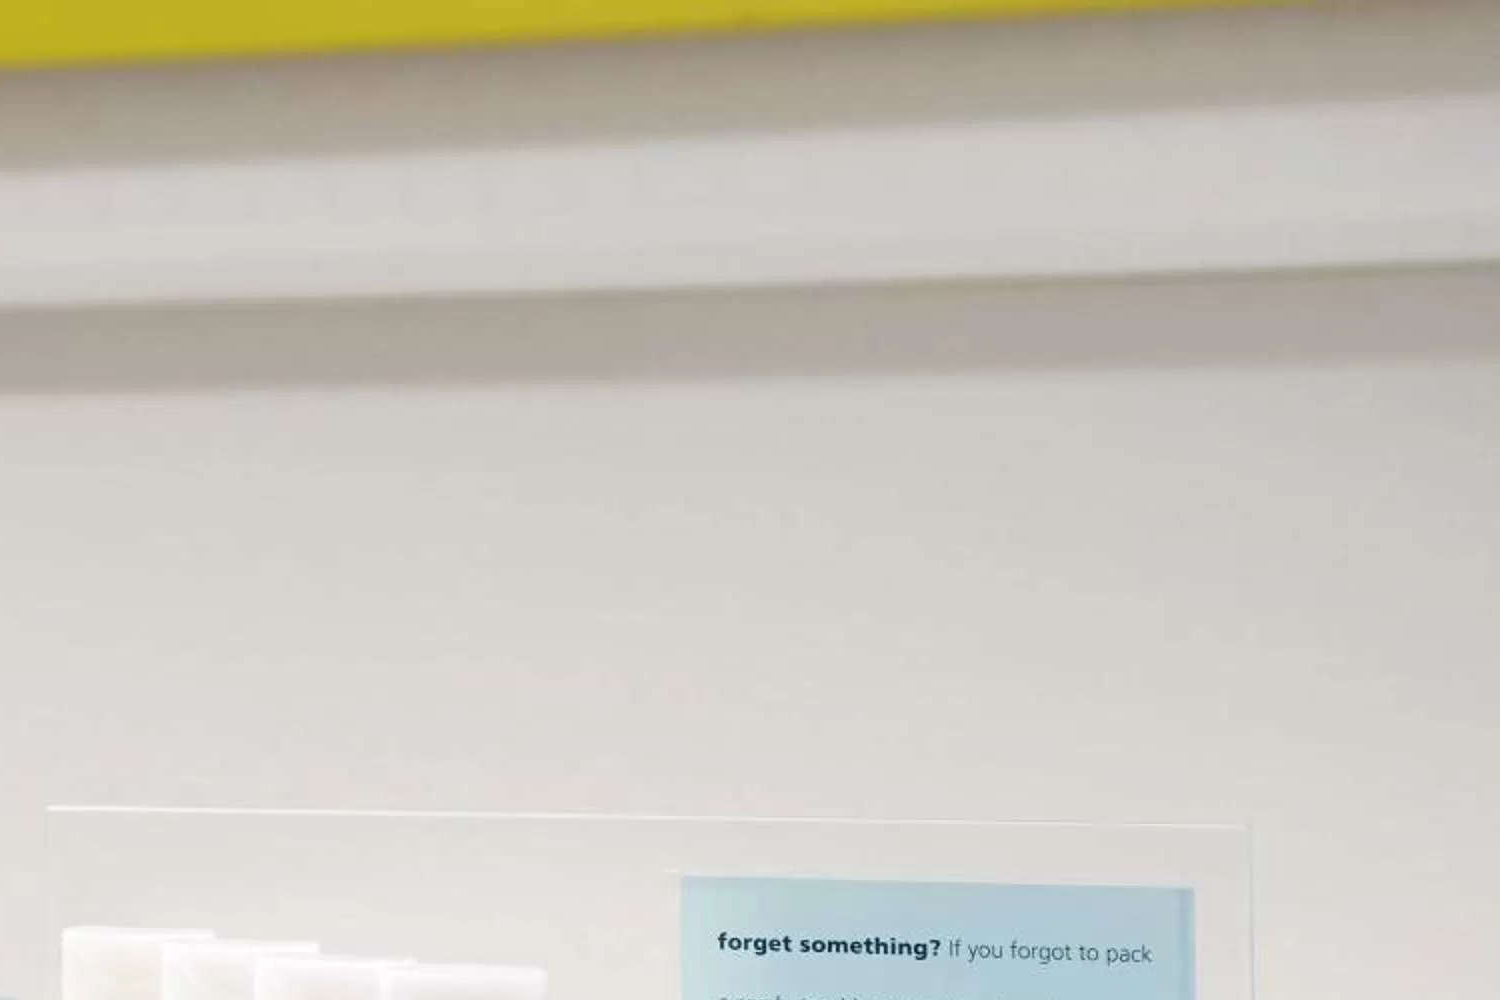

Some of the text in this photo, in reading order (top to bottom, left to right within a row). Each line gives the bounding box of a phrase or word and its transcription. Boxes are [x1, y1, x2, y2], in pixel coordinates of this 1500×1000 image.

[716, 931, 1154, 966] forget something? If you forgot to pack
